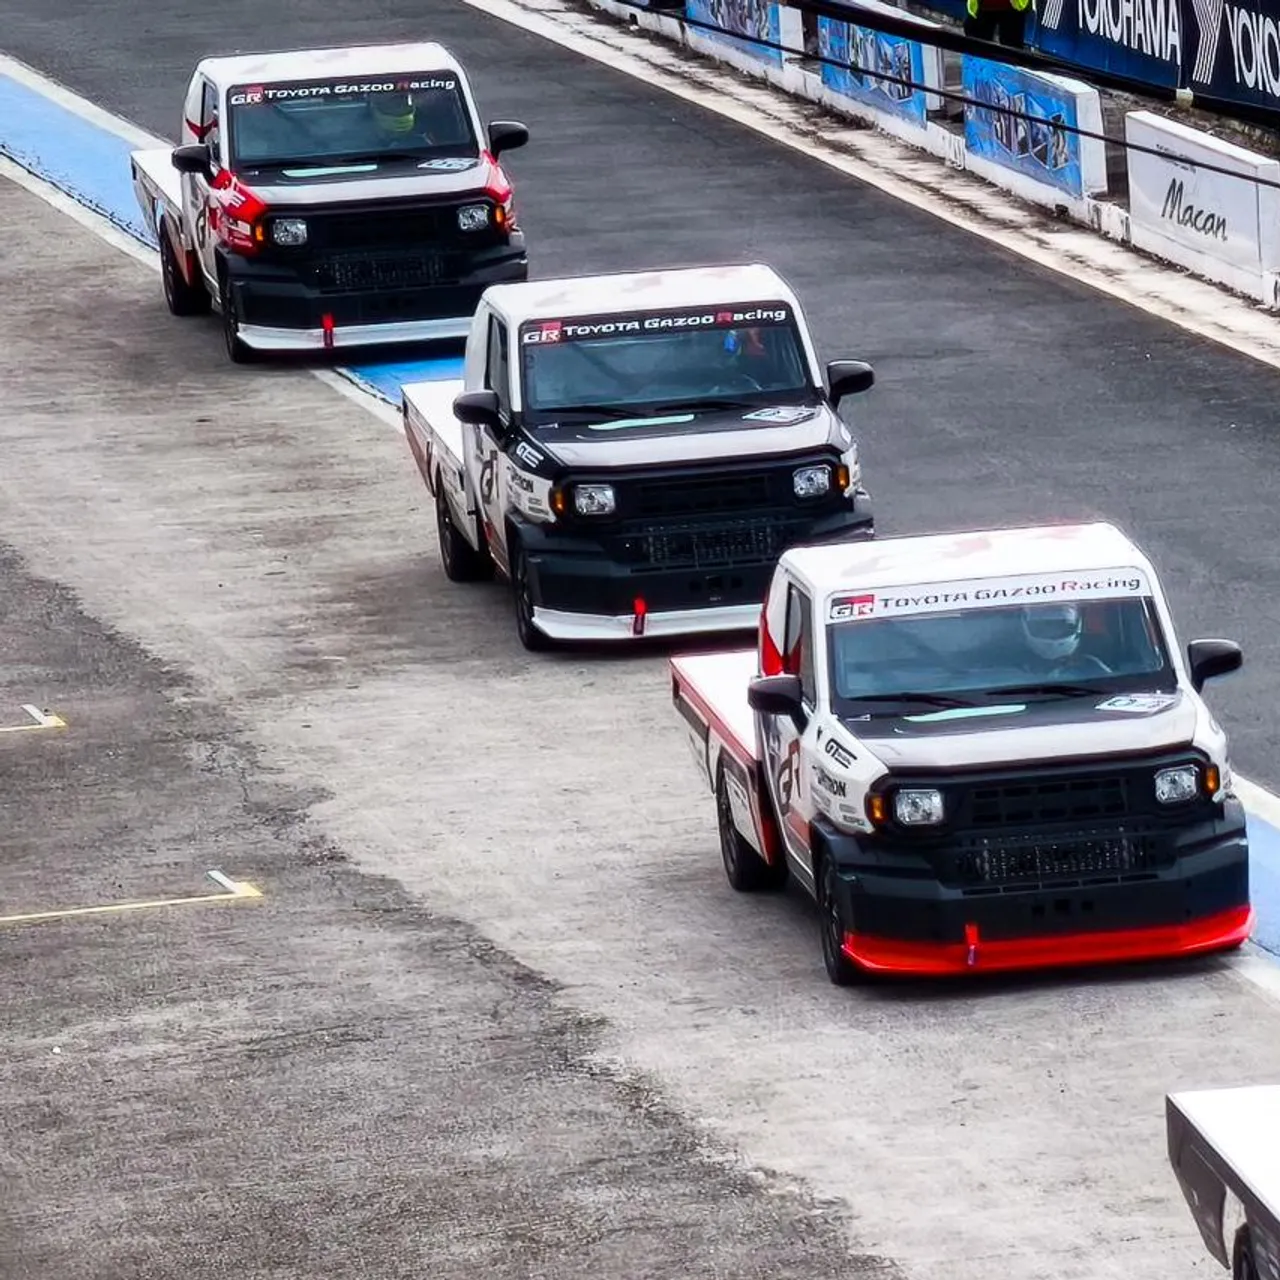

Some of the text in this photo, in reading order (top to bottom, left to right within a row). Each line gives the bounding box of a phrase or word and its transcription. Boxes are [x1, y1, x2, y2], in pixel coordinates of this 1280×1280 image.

[265, 86, 330, 100] TOYOTA
[334, 82, 395, 95] GAZOO
[396, 79, 456, 91] Racing
[1161, 177, 1228, 241] Macan
[562, 320, 640, 336] TOYOTA
[643, 314, 716, 330] GAZOO
[716, 308, 787, 325] Racing
[880, 592, 968, 609] TOYOTA
[974, 584, 1056, 600] GAZOO
[1060, 577, 1141, 592] Racing
